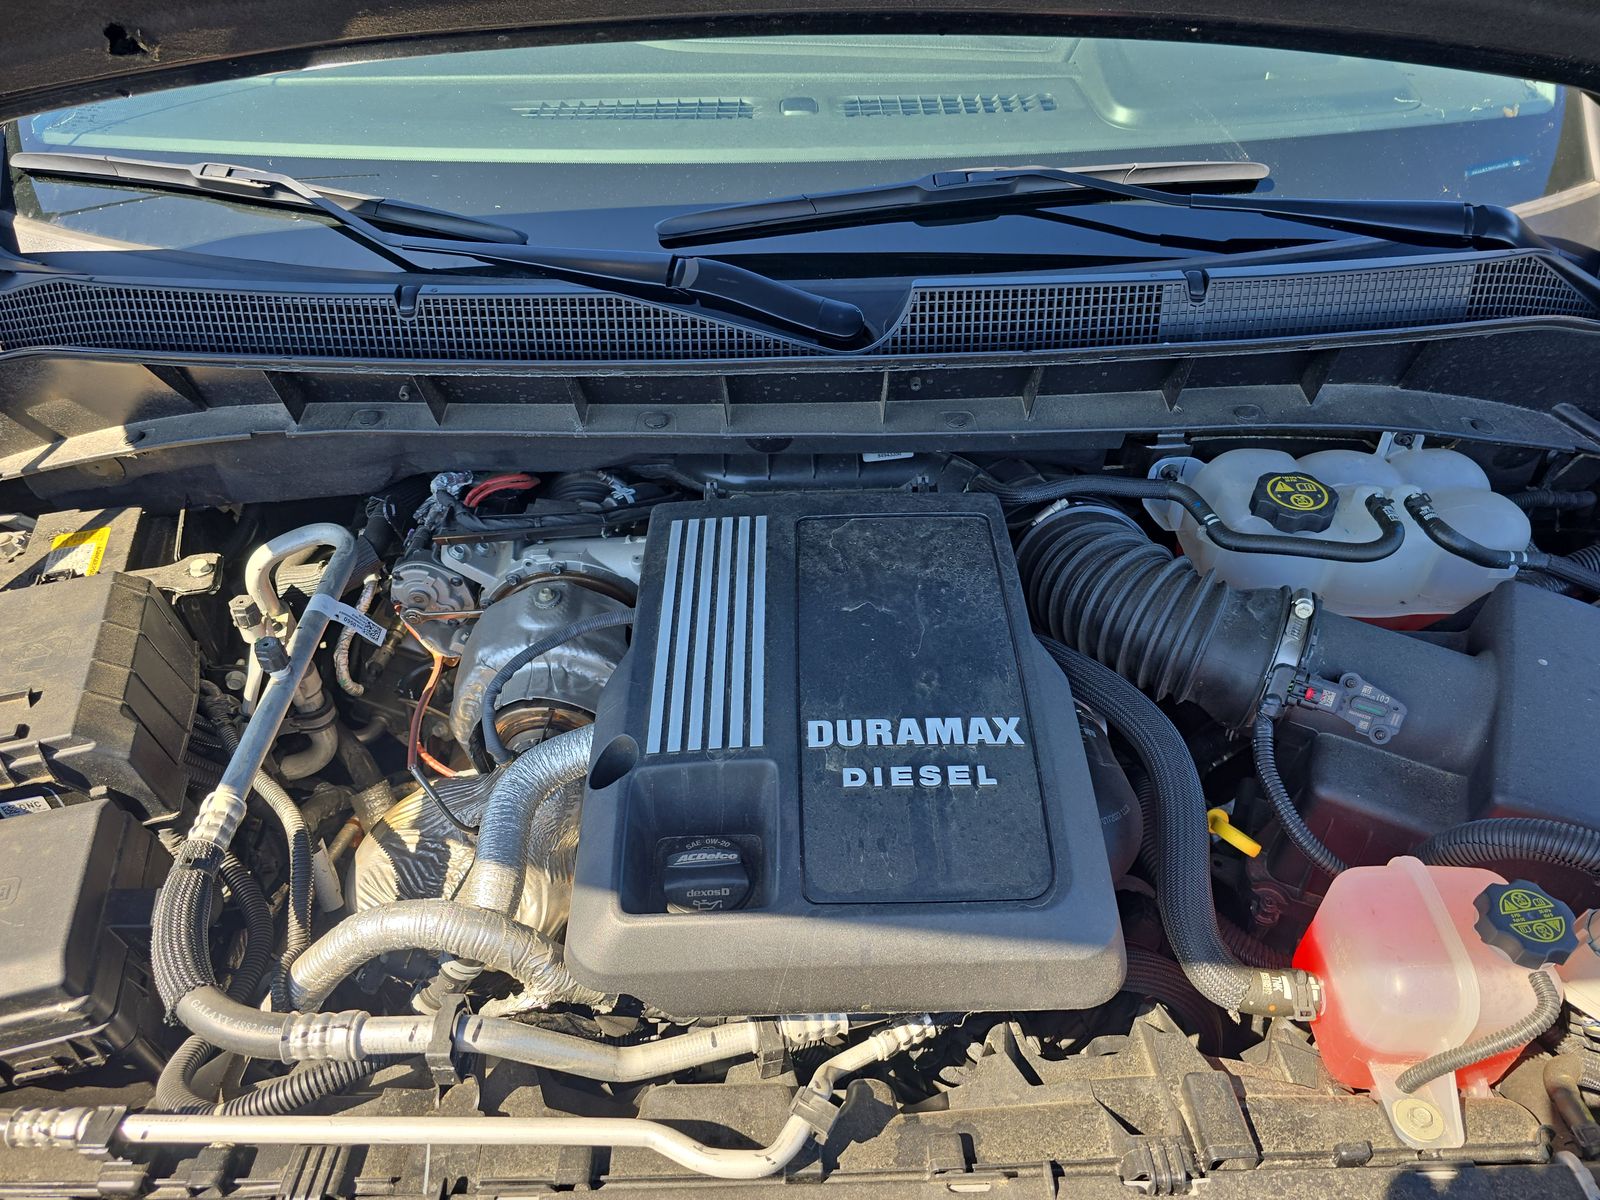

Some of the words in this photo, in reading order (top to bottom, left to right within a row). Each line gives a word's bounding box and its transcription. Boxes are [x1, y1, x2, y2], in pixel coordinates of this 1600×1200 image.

[807, 717, 1025, 748] DURAMAX
[842, 765, 998, 788] DIESEL
[685, 840, 702, 850] SAE
[705, 838, 731, 848] 0W-20
[676, 852, 738, 863] ACDelco
[191, 999, 232, 1025] GALAXY
[233, 1018, 258, 1033] 4882
